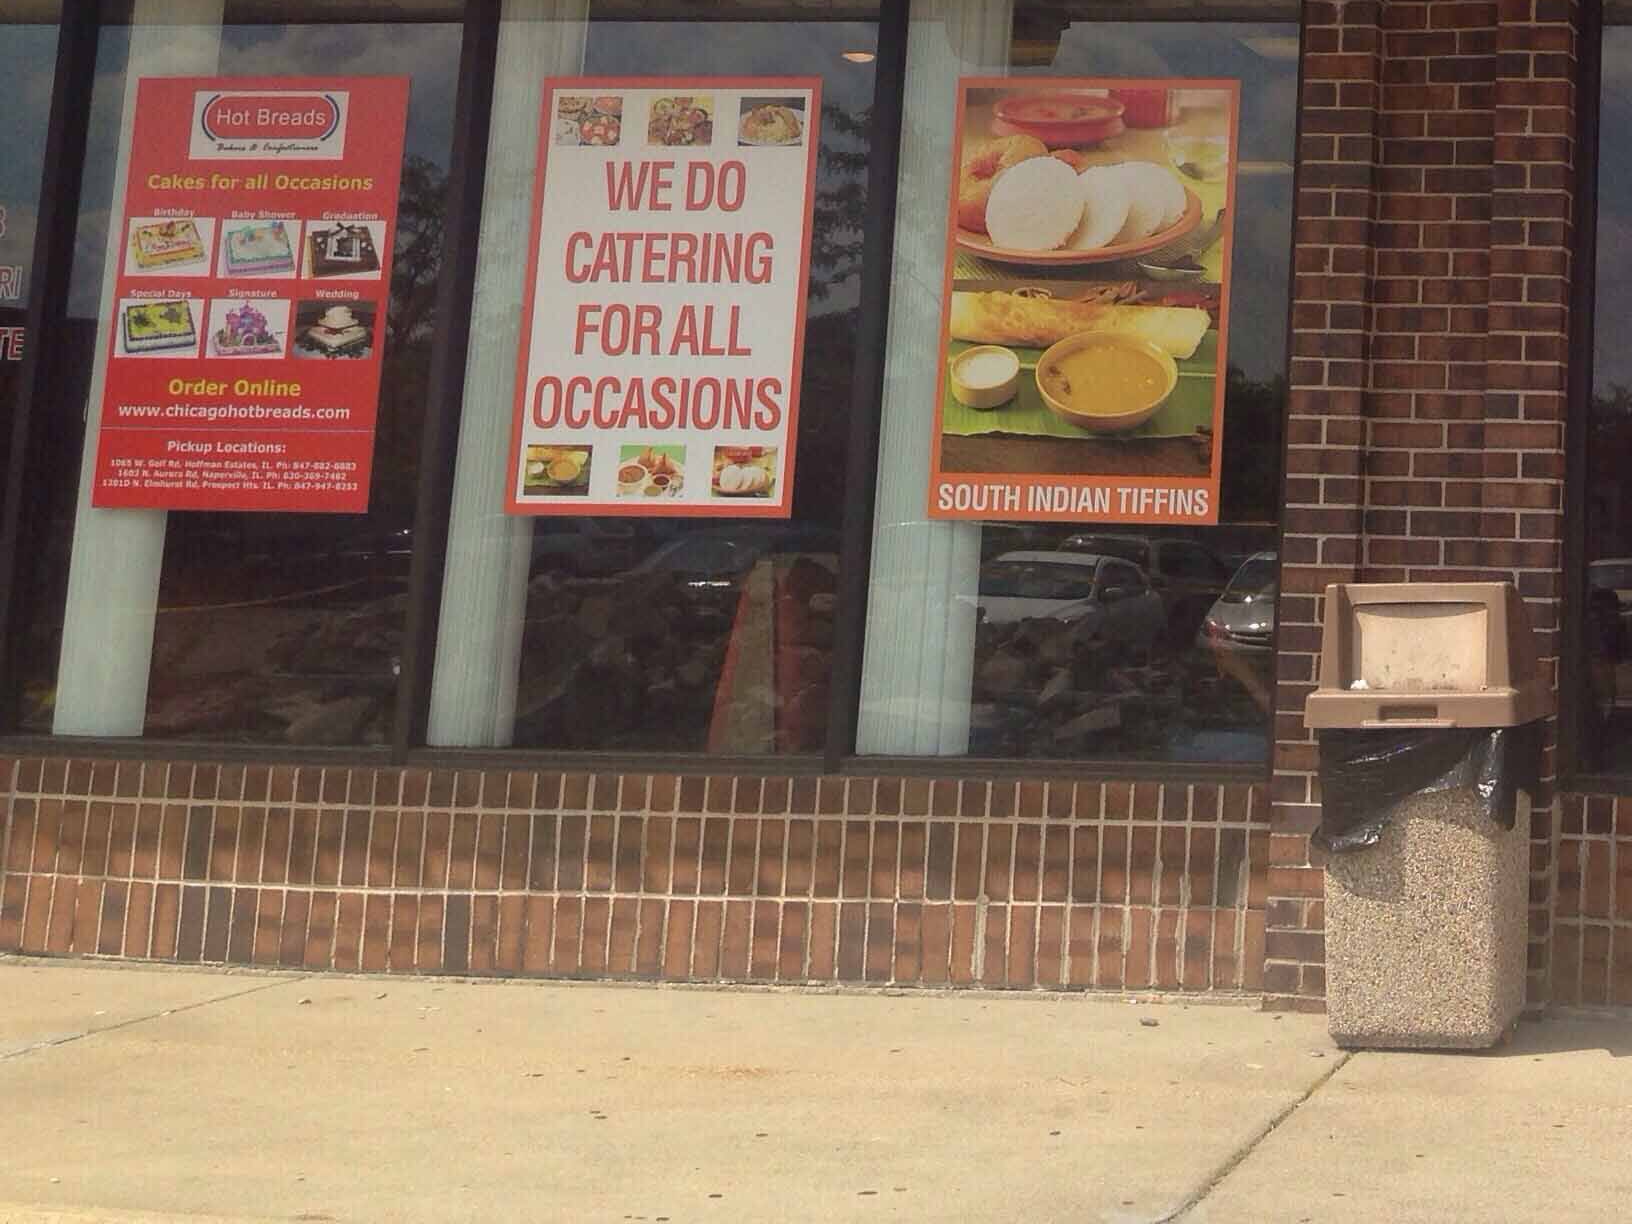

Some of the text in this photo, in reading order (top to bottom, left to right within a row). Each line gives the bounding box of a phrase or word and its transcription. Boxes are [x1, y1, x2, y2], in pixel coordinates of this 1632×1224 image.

[217, 108, 326, 126] Hot Breads
[148, 174, 374, 191] Cakes for all Occasions
[606, 160, 747, 212] WE DO
[154, 207, 195, 218] Birthday
[232, 209, 298, 220] Baby Shower
[322, 211, 379, 220] Graduation
[565, 232, 774, 285] CATERING
[130, 289, 192, 300] Special Days
[229, 288, 278, 298] Signature
[315, 289, 360, 300] Wedding
[574, 304, 752, 357] FOR ALL
[168, 378, 302, 397] Order Online
[533, 375, 782, 431] OCCASIONS
[118, 403, 350, 421] www.chicagohotbreads.com
[168, 440, 286, 455] Pickup Locations:
[938, 483, 1209, 517] SOUTH INDIAN TIFFINS
